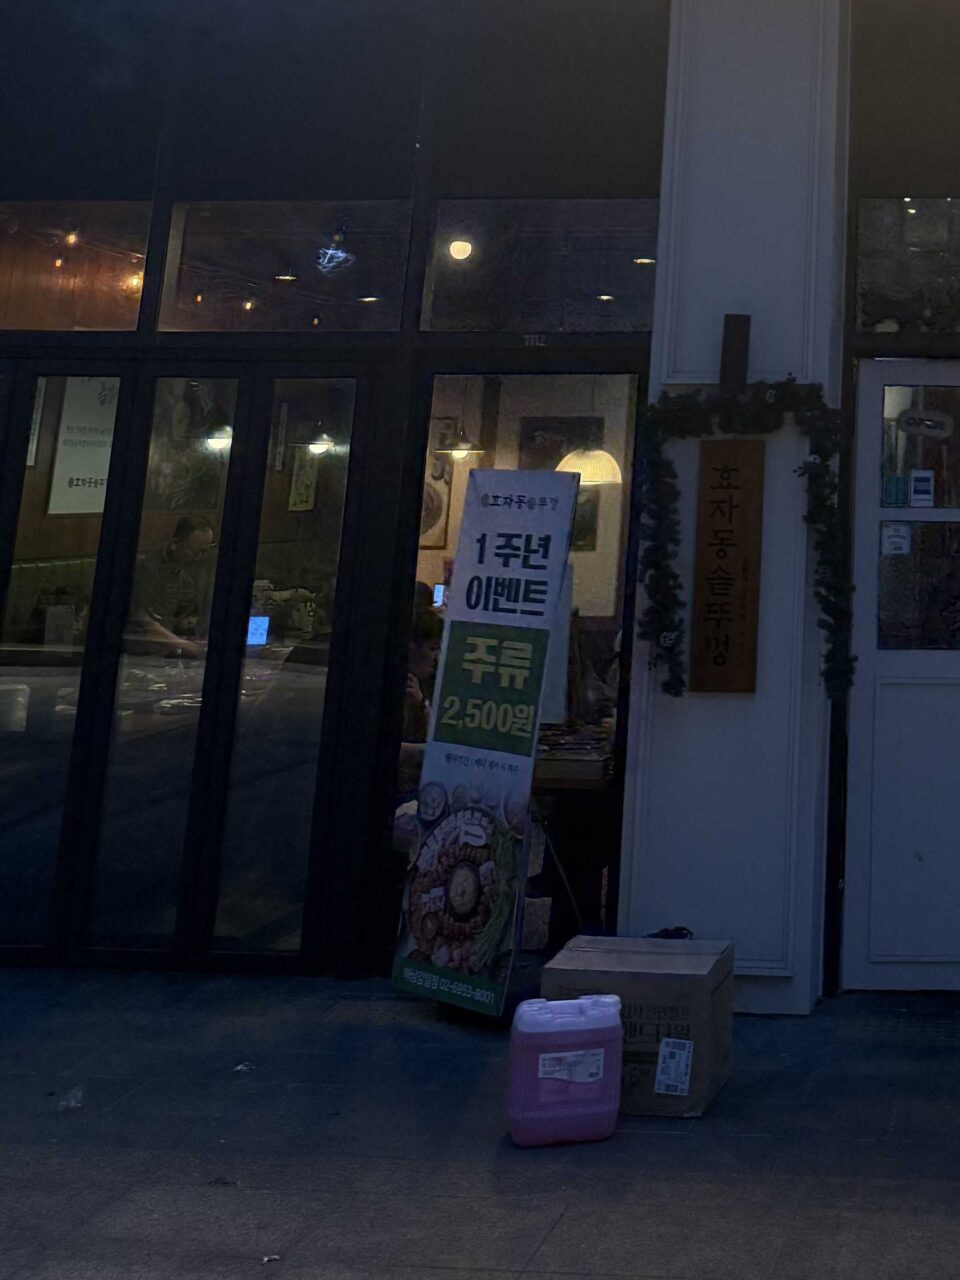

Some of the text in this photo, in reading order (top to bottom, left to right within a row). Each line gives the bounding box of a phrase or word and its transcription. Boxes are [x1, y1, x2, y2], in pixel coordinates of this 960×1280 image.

[702, 464, 742, 667] 효자동솥뚜껑
[466, 575, 548, 616] 이벤트
[462, 636, 533, 690] 주류
[440, 696, 535, 738] 2,500원
